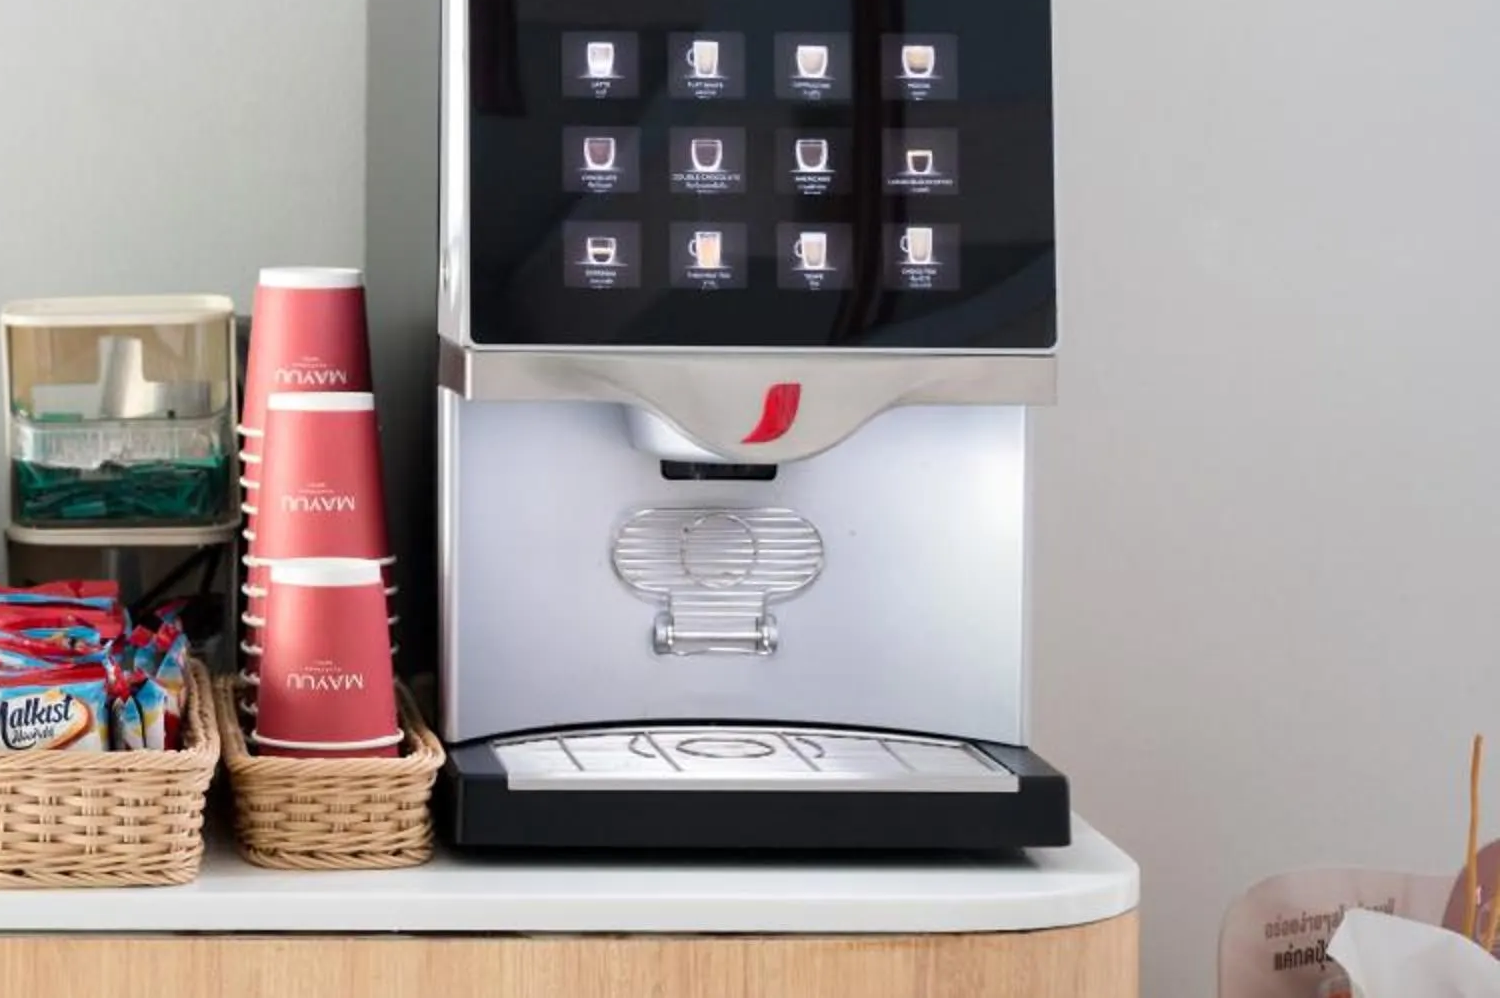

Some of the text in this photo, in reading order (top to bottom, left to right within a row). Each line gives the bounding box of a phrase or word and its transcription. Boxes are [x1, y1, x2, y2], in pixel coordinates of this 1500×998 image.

[274, 369, 349, 385] MAYUU
[281, 495, 357, 512] MAYUU
[286, 673, 364, 691] MAYUU
